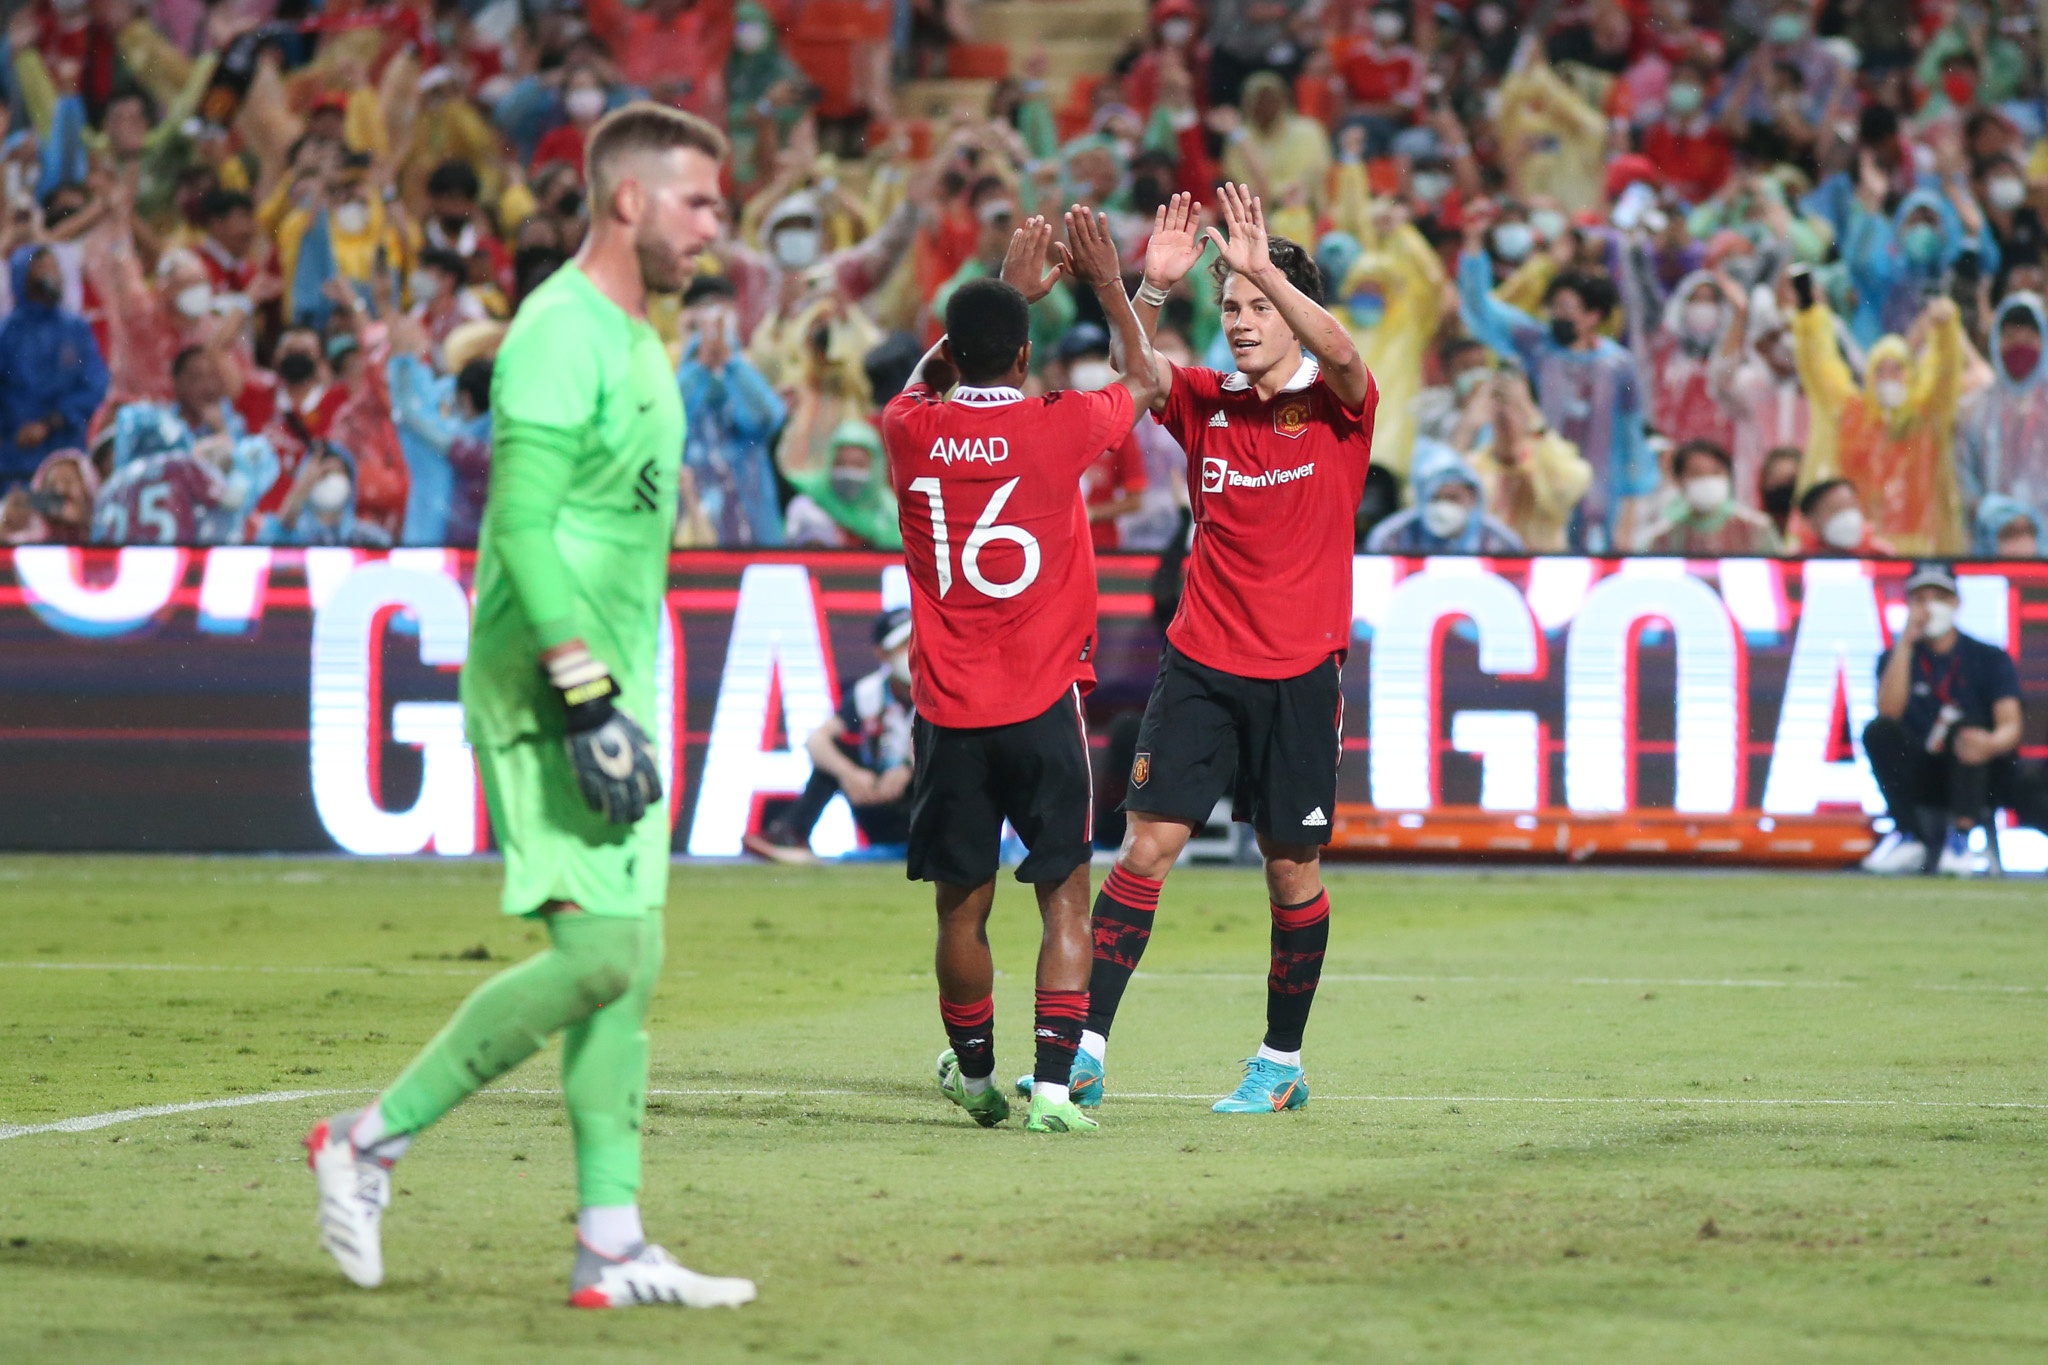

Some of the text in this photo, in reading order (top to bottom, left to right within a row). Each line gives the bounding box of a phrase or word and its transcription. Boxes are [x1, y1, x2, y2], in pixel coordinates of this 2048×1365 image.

[929, 436, 1009, 466] AMAD
[1227, 462, 1315, 487] TeamViewer
[908, 476, 1041, 600] 16
[308, 560, 916, 857] GA
[1302, 818, 1328, 826] adidas
